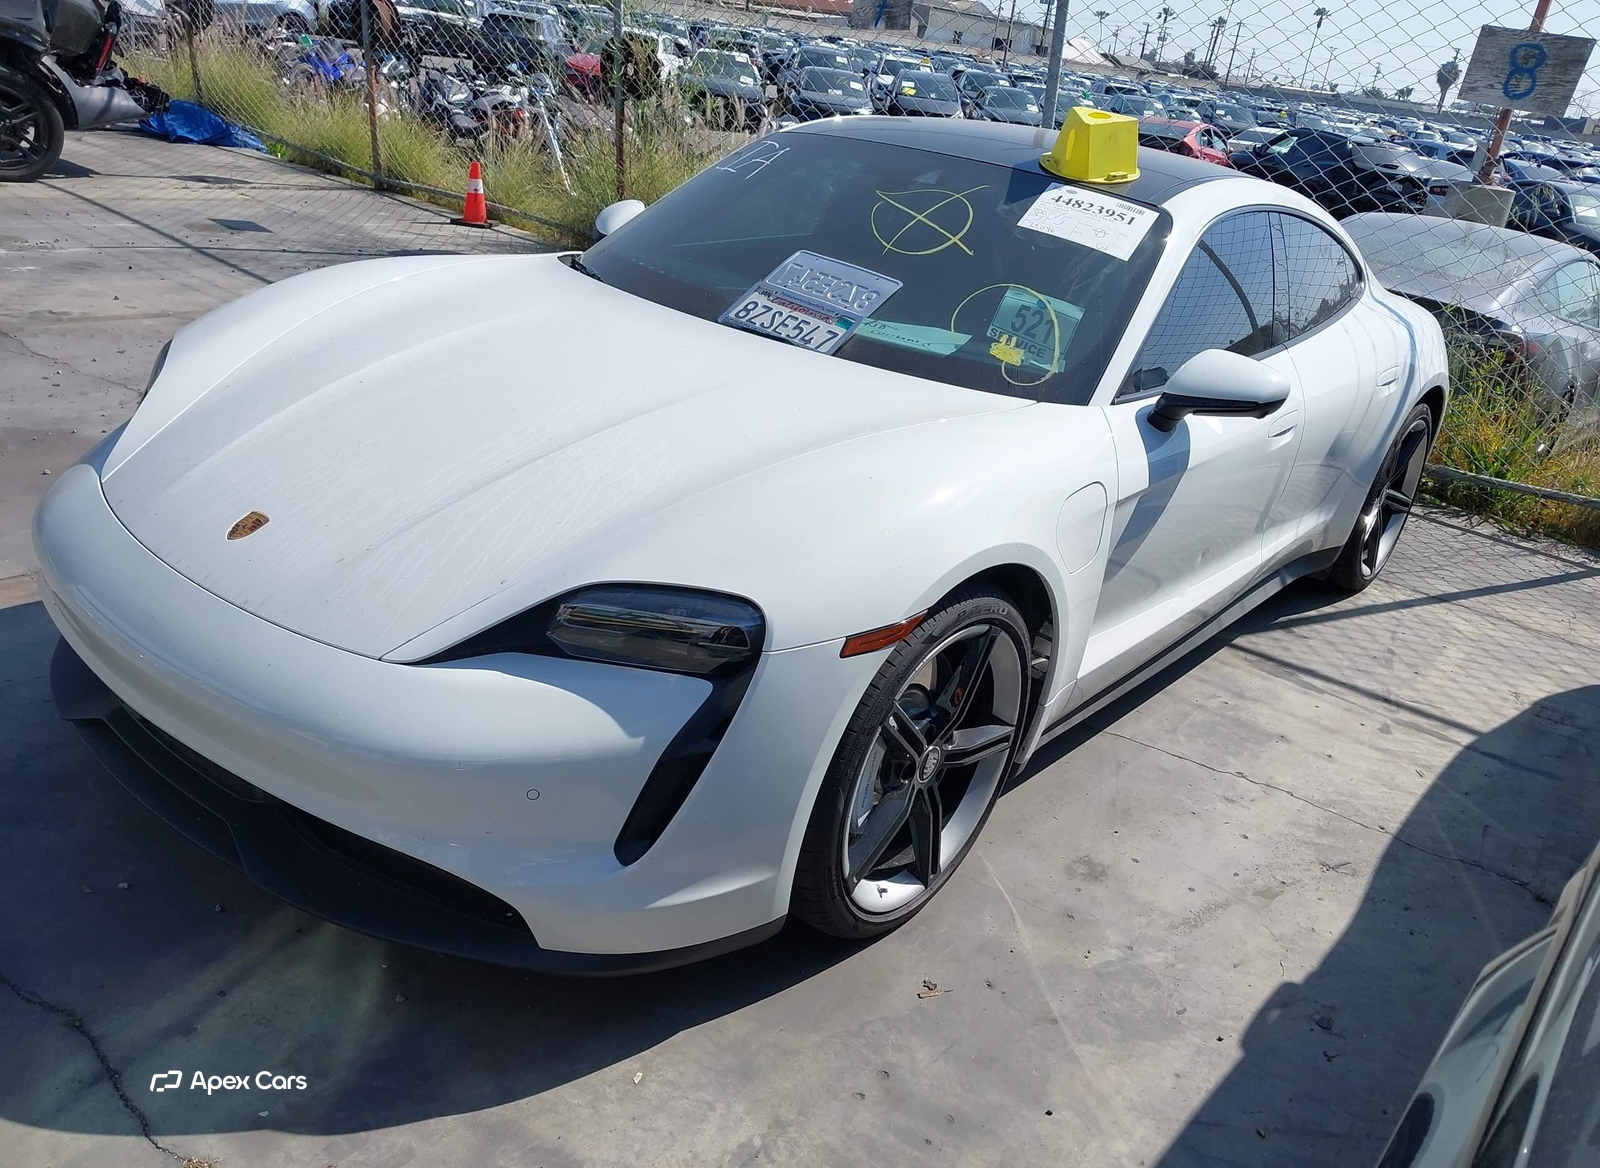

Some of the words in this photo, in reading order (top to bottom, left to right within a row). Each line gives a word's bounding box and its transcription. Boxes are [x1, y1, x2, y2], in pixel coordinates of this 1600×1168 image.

[1502, 42, 1547, 101] 8
[1051, 195, 1136, 226] 44823951
[733, 300, 840, 351] 8ZSE547
[769, 294, 835, 325] California
[1010, 304, 1056, 345] 521
[971, 603, 1009, 616] ZERO
